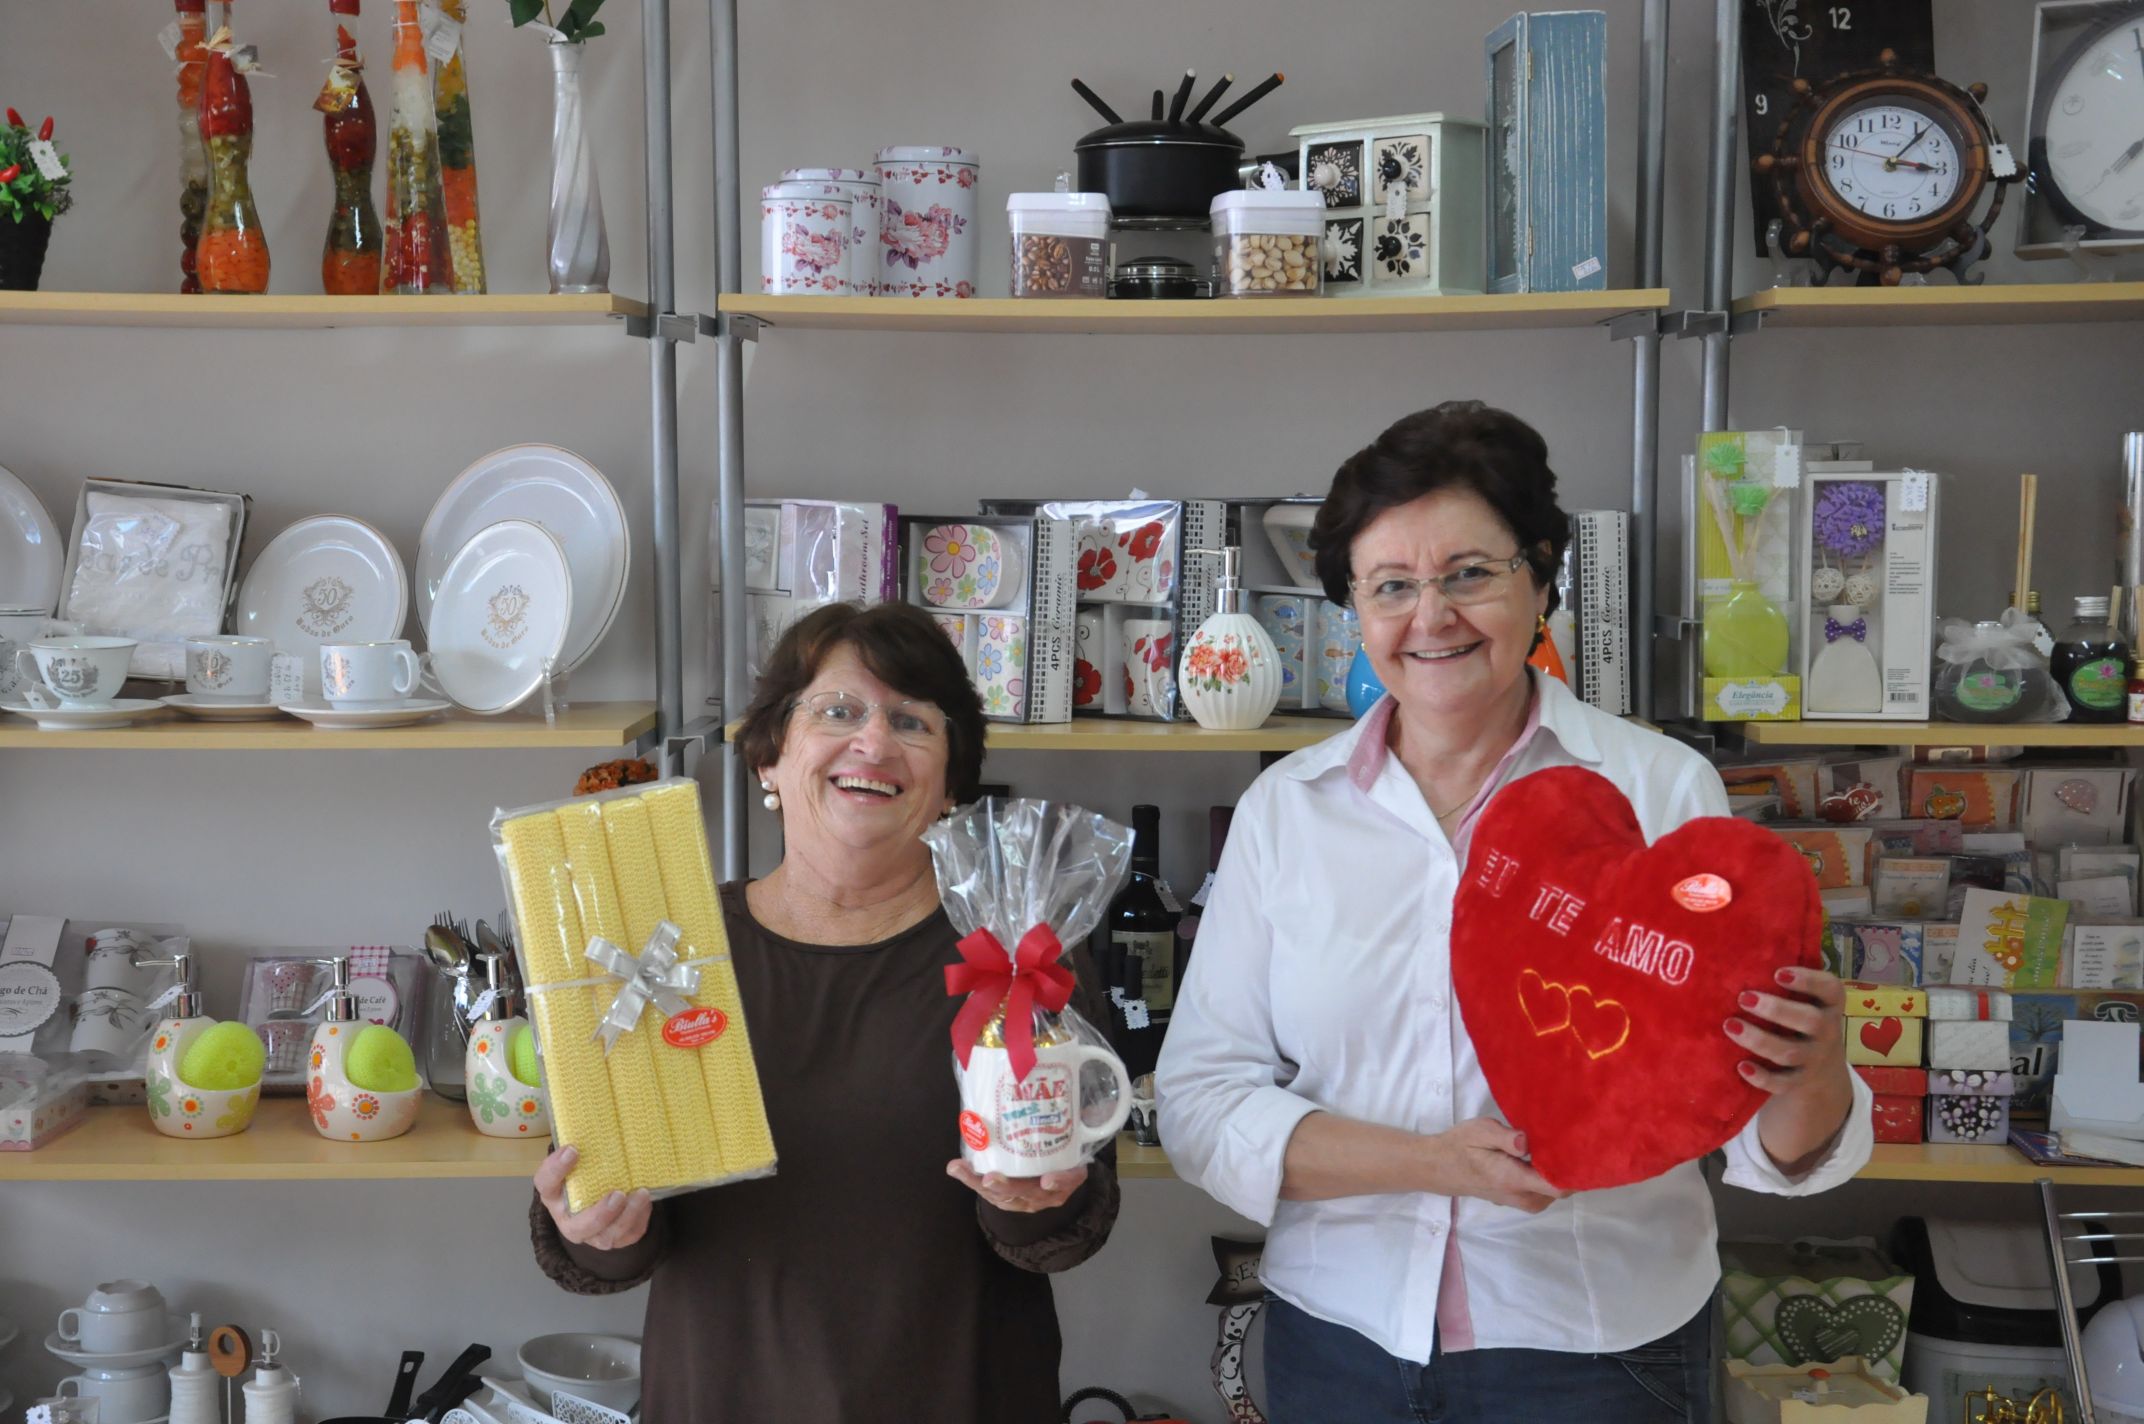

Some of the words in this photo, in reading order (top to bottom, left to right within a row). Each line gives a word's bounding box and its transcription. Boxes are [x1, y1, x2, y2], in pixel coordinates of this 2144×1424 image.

[1828, 7, 1851, 29] 12
[1755, 94, 1768, 115] 9
[1858, 119, 1873, 133] 11
[1882, 114, 1901, 129] 12
[1840, 134, 1857, 148] 10
[1929, 139, 1940, 153] 2
[1833, 154, 1844, 169] 9
[1935, 161, 1947, 175] 3
[1840, 177, 1853, 192] 8
[1928, 183, 1940, 196] 4
[1858, 196, 1868, 212] 7
[1883, 202, 1896, 218] 6
[1908, 197, 1921, 212] 5
[317, 588, 337, 605] 50
[1052, 574, 1063, 631] Ceramic
[1602, 566, 1612, 624] Ceramic
[1051, 636, 1062, 671] 4PCS
[1602, 630, 1613, 664] 4PCS
[61, 669, 81, 684] 25
[1529, 884, 1586, 937] TE
[1594, 917, 1694, 985] AMO
[14, 986, 26, 995] de
[2010, 1047, 2043, 1076] al
